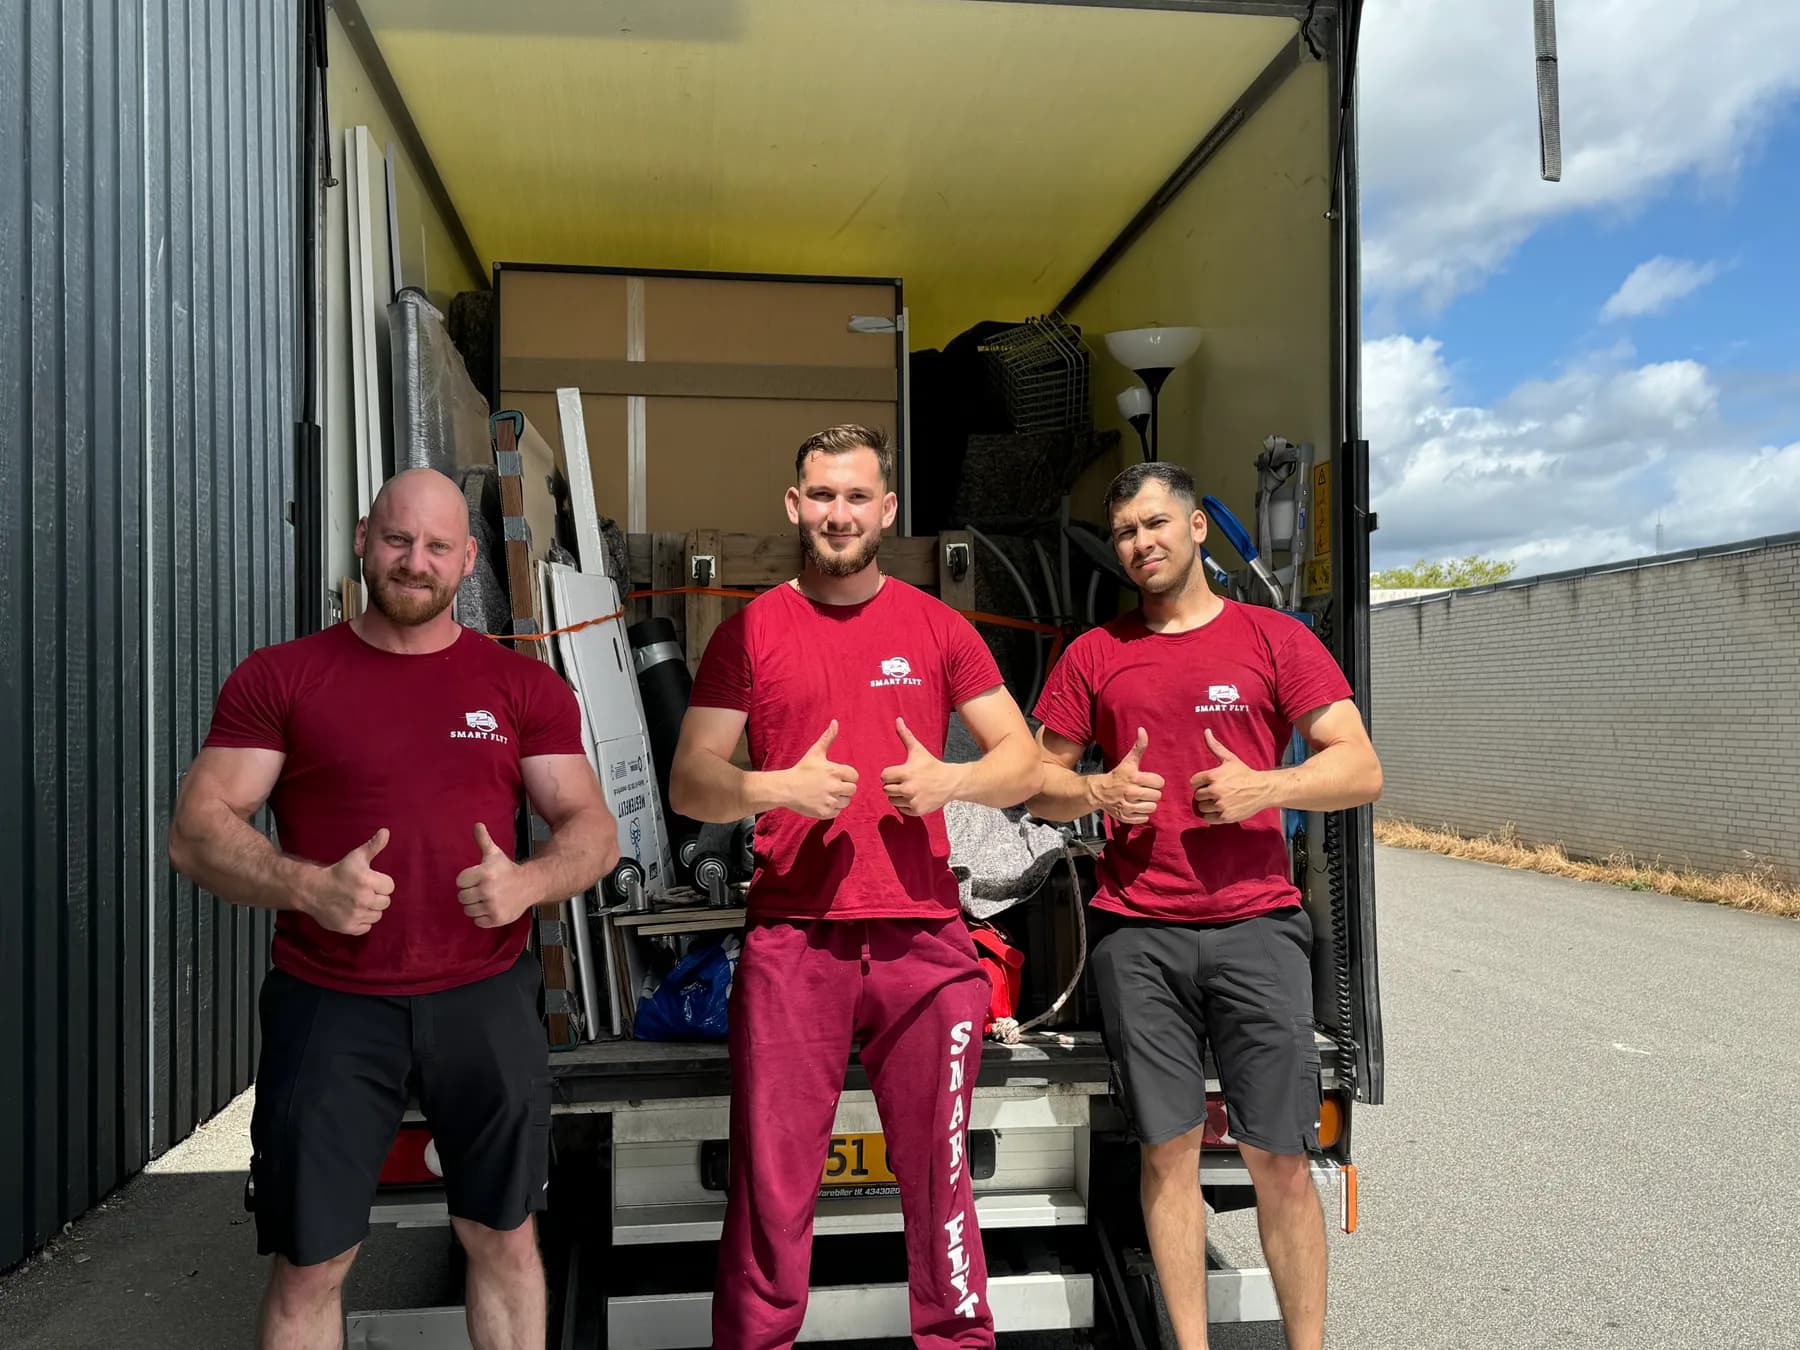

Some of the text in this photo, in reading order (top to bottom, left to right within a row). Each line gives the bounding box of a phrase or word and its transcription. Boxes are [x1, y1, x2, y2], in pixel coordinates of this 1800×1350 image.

[870, 677, 922, 687] SMART FLYT
[1195, 704, 1227, 713] SMART
[450, 730, 488, 740] SMART
[826, 1137, 869, 1177] 51
[944, 1210, 980, 1319] FLYT
